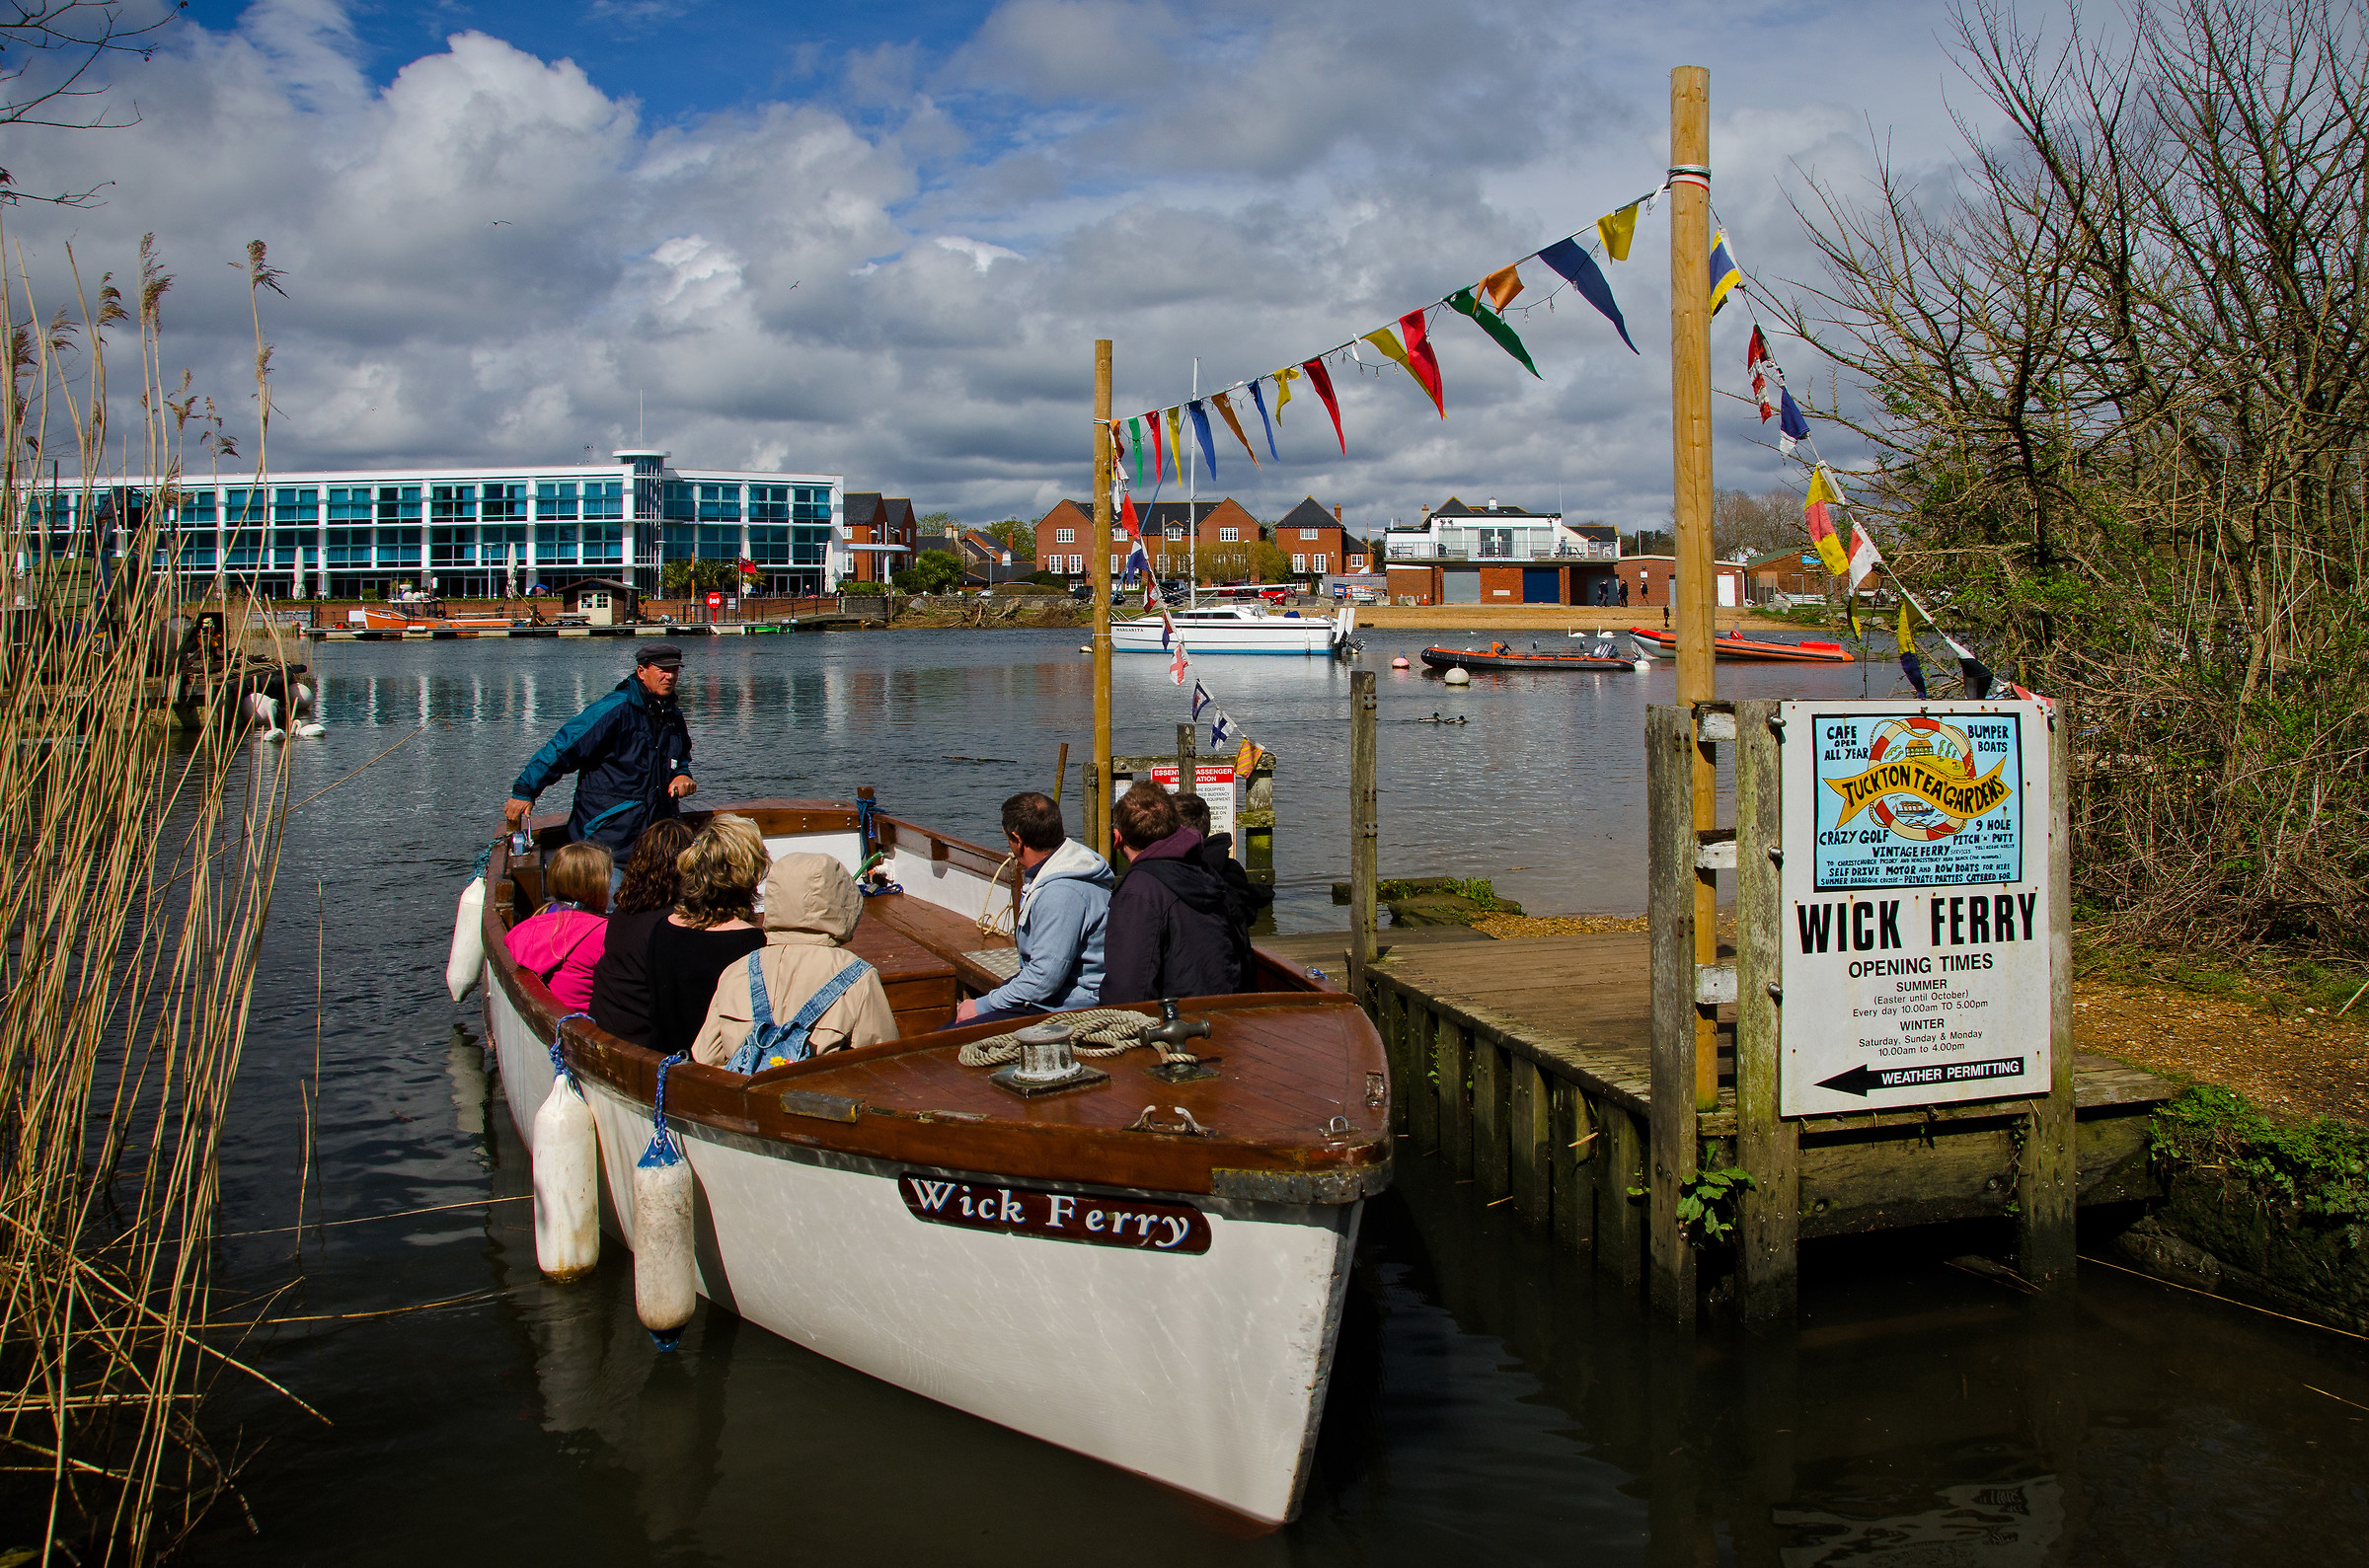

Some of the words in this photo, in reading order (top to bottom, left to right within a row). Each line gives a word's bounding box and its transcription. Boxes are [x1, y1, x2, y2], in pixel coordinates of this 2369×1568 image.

[1826, 726, 1858, 740] CAFE
[1967, 725, 2009, 739] BUMPER
[1824, 749, 1842, 761] ALL
[1845, 747, 1869, 760] YEAR
[1978, 741, 2008, 753] BOATS
[1842, 766, 1911, 807] TUCKTON
[1915, 767, 1942, 800] TEA
[1943, 775, 2005, 813] GARDENS
[1976, 820, 1982, 832] 9
[1987, 820, 2012, 831] HOLE
[1819, 830, 1860, 846] CRAZY
[1860, 829, 1889, 844] GOLF
[1953, 834, 1979, 845] PITCH
[1992, 834, 2014, 843] PUTT
[1872, 847, 1919, 858] VINTAGE
[1921, 846, 1950, 857] FERRY
[1829, 868, 1850, 877] SELF
[1852, 867, 1879, 876] DRIVE
[1886, 866, 1916, 875] MOTOR
[1935, 864, 1953, 873] ROW
[1955, 863, 1979, 872] BOATS
[1935, 874, 1963, 883] PARTIES
[1966, 873, 1996, 882] CATERED
[1797, 900, 1902, 954] WICK
[1931, 893, 2036, 946] FERRY
[1849, 957, 1932, 979] OPENING
[1940, 953, 1993, 972] TIMES
[1896, 979, 1948, 992] SUMMER
[1873, 996, 1906, 1006] (Easter
[1909, 993, 1928, 1003] until
[1931, 990, 1969, 1002] October)
[1853, 1008, 1877, 1018] Every
[1881, 1007, 1898, 1016] day
[1901, 1004, 1938, 1014] 10.00am
[1956, 1000, 1988, 1010] 5.00pm
[1900, 1018, 1945, 1031] WINTER
[1859, 1036, 1901, 1048] Saturday,
[1905, 1033, 1937, 1045] Sunday
[1950, 1030, 1983, 1041] Monday
[1878, 1046, 1916, 1057] 10.00am
[1932, 1042, 1965, 1053] 4.00pm
[1881, 1069, 1942, 1085] WEATHER
[1948, 1061, 2020, 1080] PERMITTING
[908, 1178, 1026, 1224] Wick
[1045, 1195, 1189, 1248] Ferry
